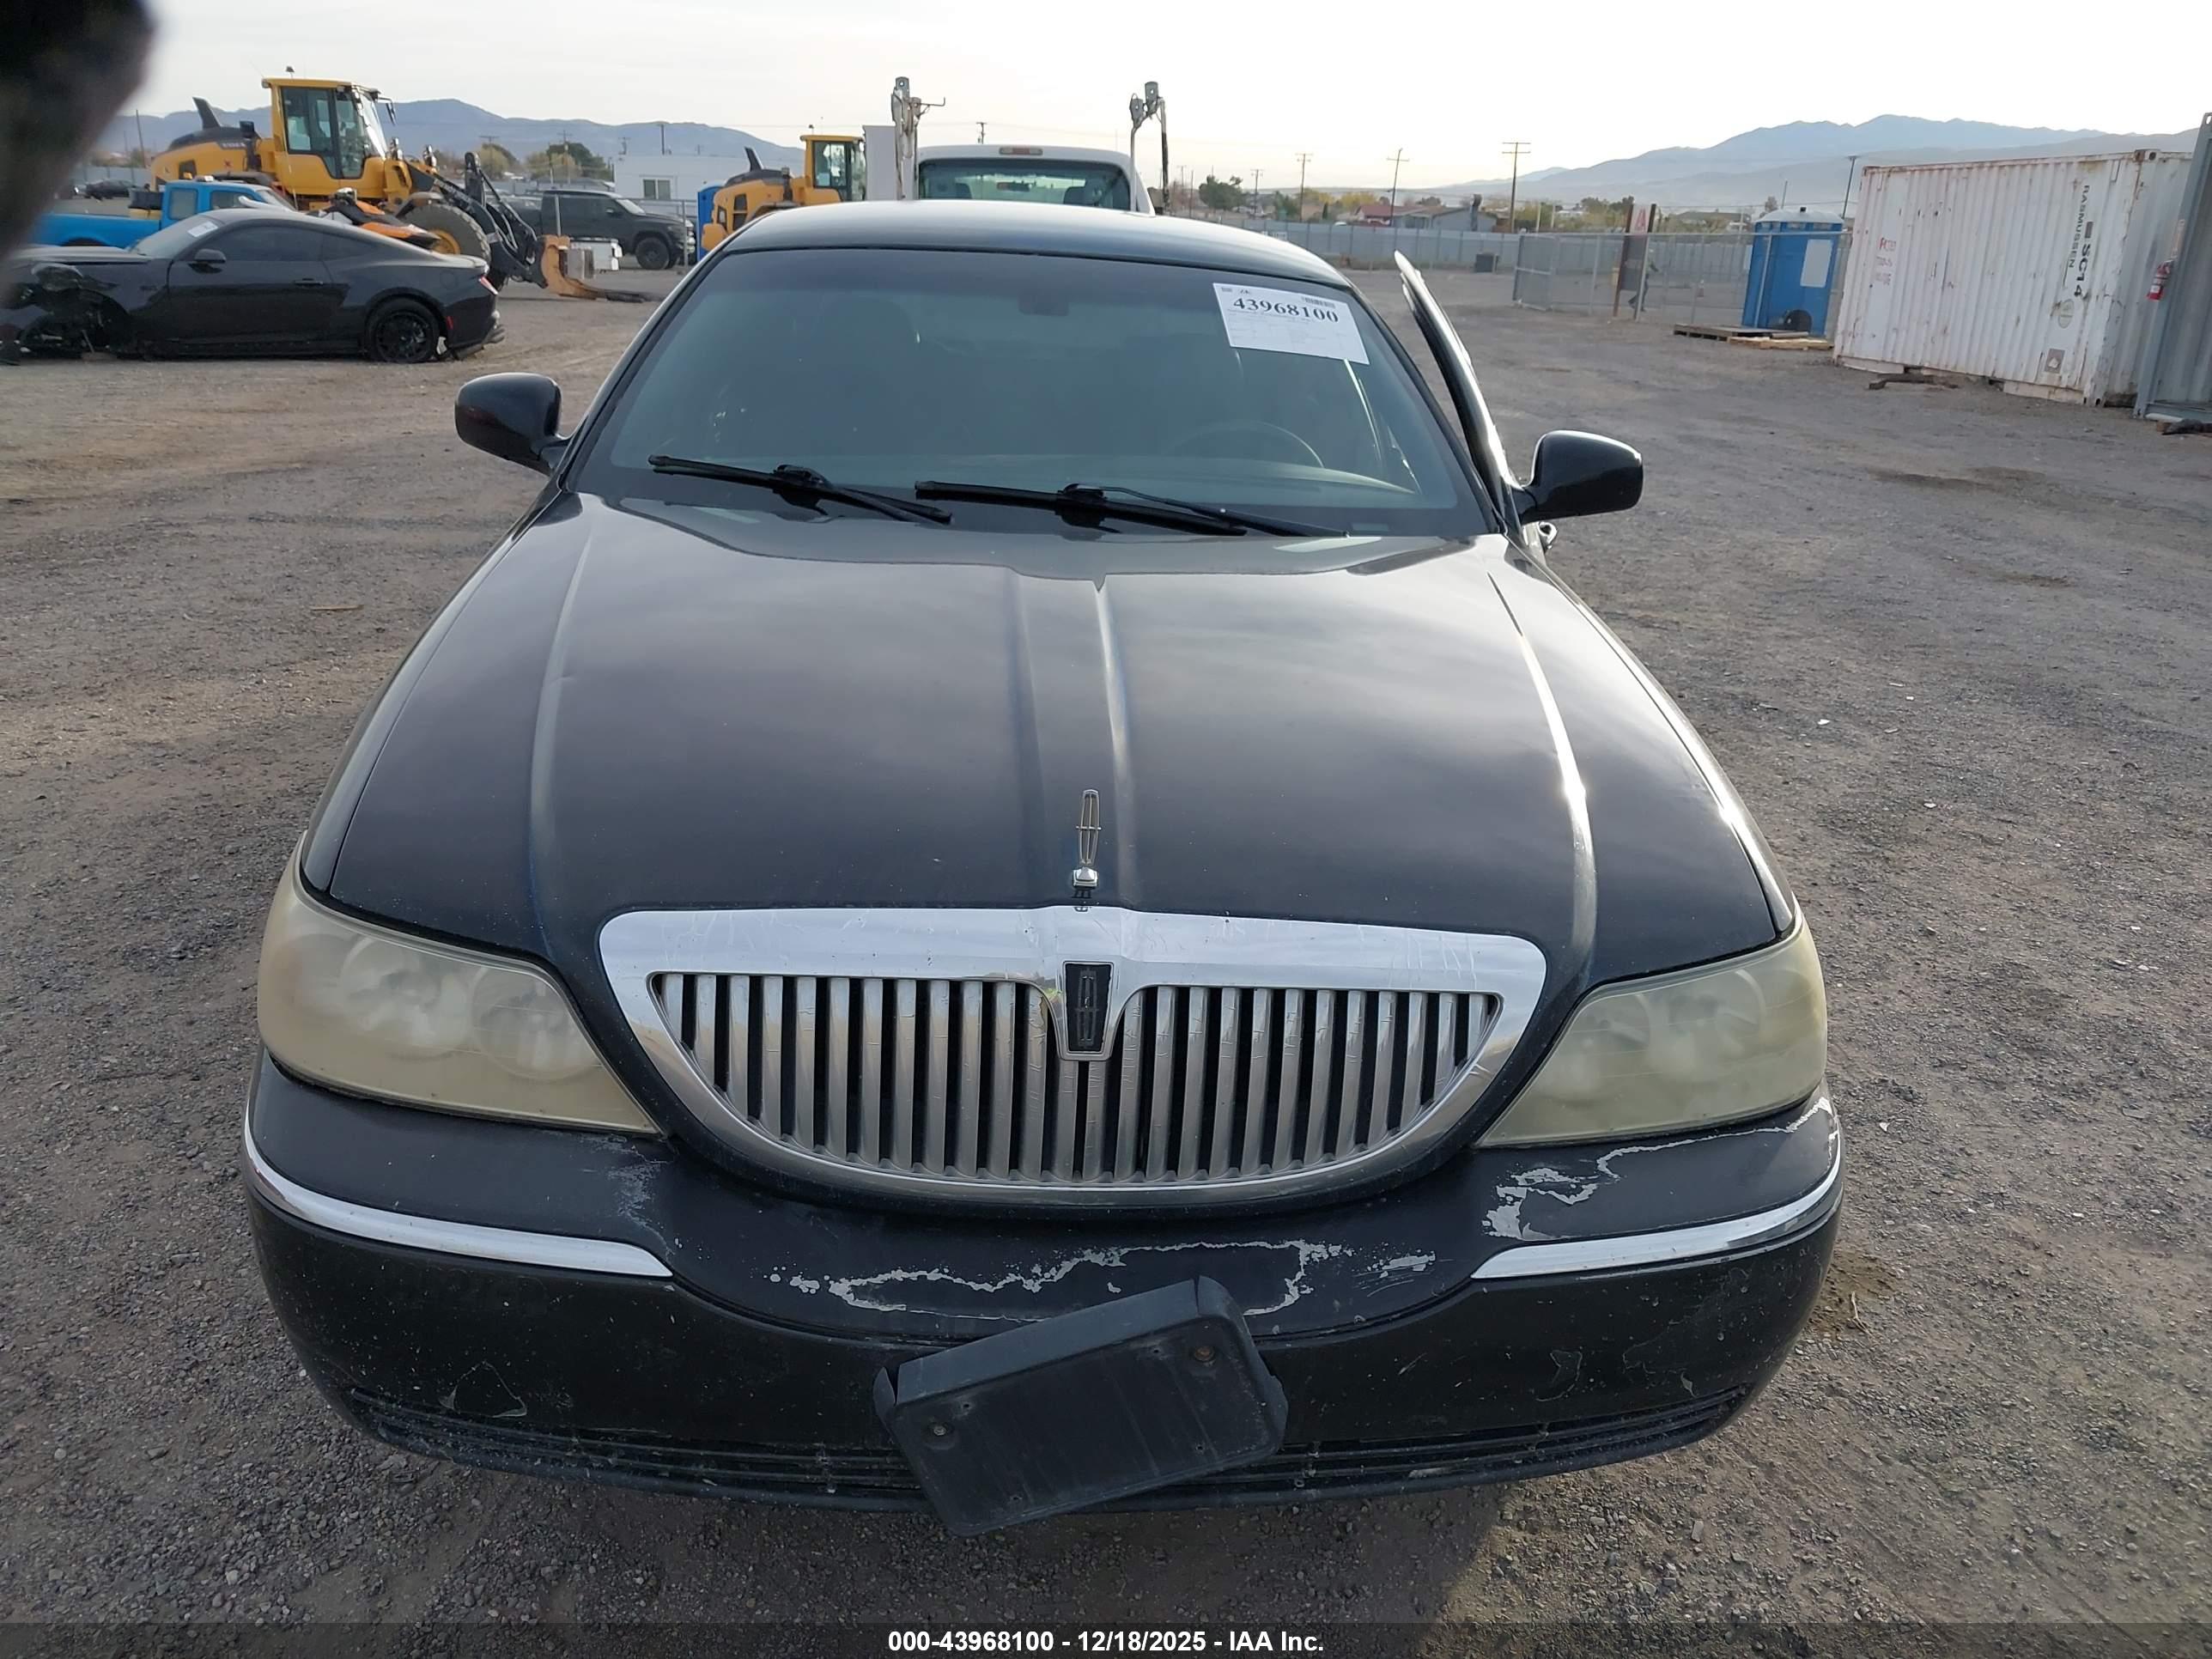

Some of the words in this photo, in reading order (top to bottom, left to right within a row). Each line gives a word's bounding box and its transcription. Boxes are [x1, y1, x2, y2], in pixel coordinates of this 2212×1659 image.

[2068, 185, 2090, 268] RASMUSSEN
[2074, 243, 2091, 297] SC14
[1233, 297, 1339, 323] 43968100
